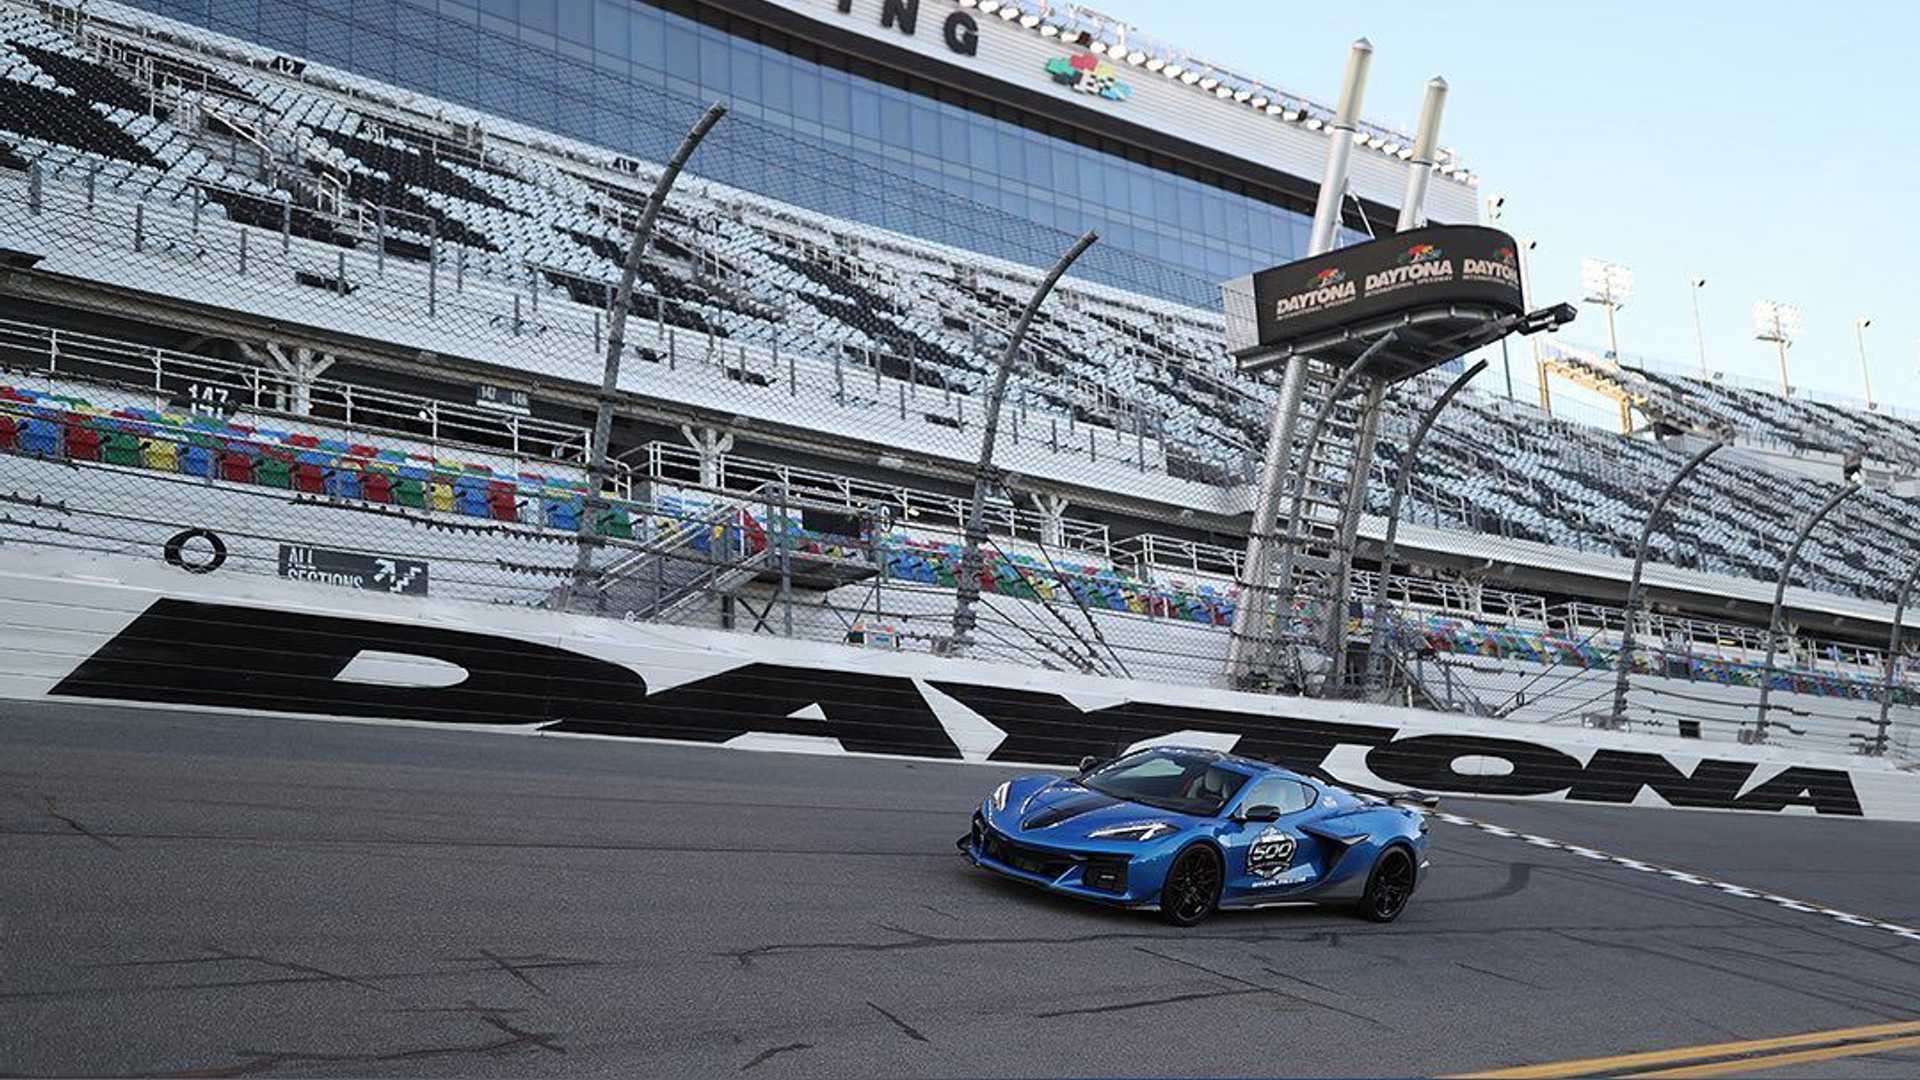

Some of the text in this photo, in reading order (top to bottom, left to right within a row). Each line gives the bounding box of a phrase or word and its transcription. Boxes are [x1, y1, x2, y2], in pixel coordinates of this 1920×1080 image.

[1366, 260, 1453, 290] DAYTONA
[1276, 281, 1356, 315] DAYTONA
[288, 547, 316, 569] ALL
[47, 597, 1864, 816] DAYTONA
[1253, 842, 1291, 861] 500
